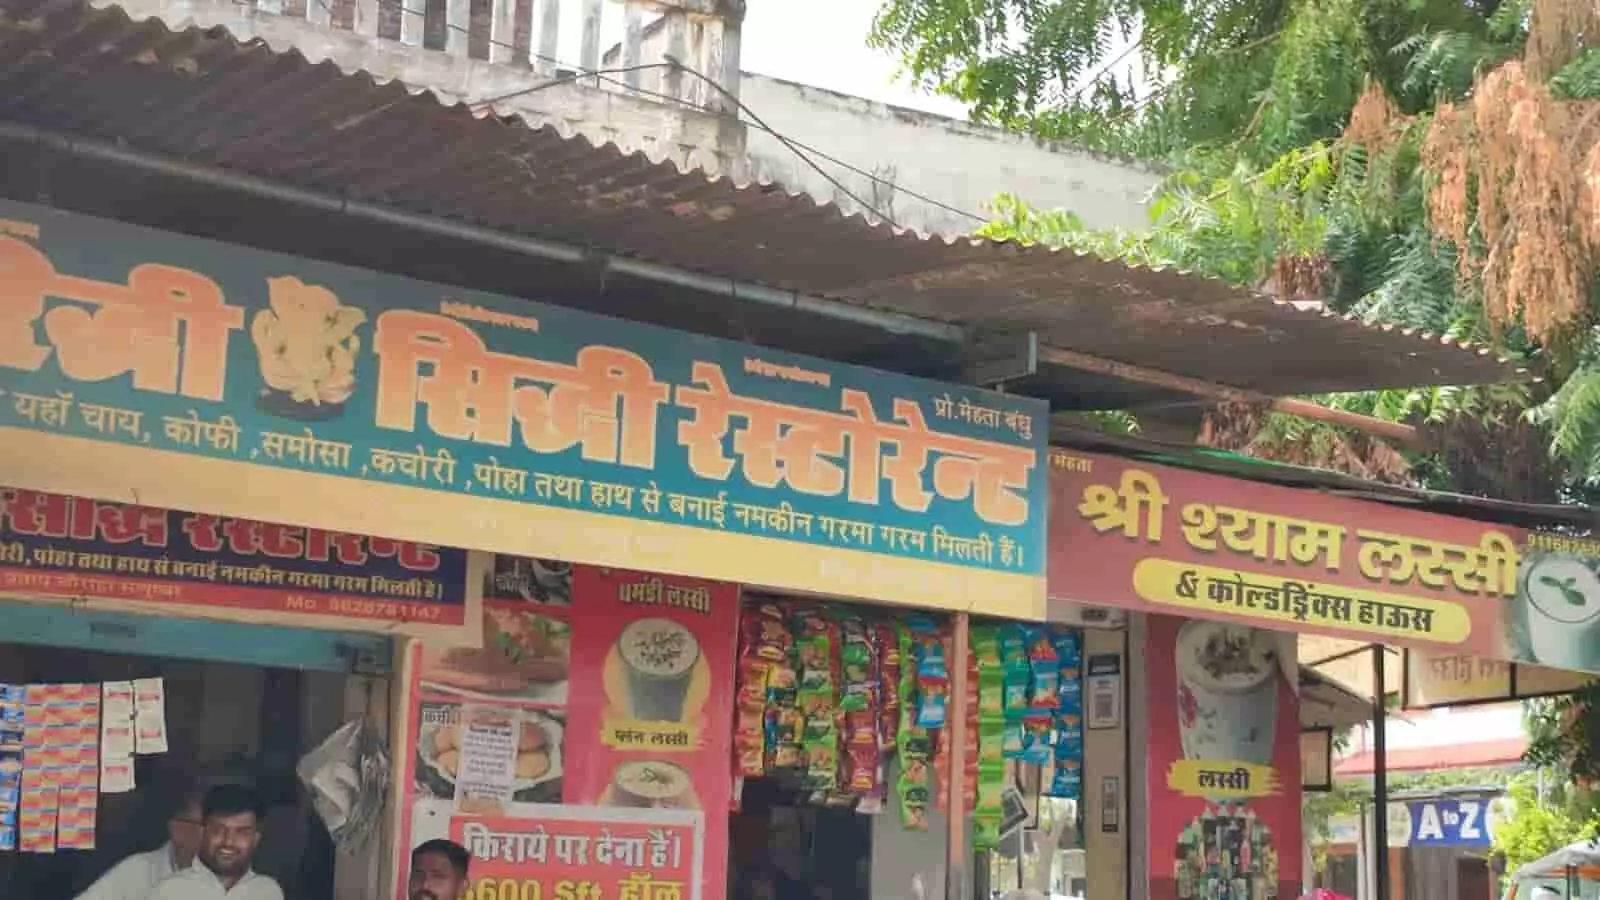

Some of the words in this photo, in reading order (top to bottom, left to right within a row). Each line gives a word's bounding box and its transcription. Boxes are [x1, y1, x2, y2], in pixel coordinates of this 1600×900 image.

[675, 360, 1035, 526] रेस्टोरेन्ट
[162, 411, 241, 454] कोफी
[533, 472, 584, 501] तथा
[589, 482, 634, 511] हाथ
[641, 481, 663, 513] से
[669, 491, 728, 528] बनाई
[733, 502, 813, 536] नमकीन
[819, 515, 874, 545] गरमा
[880, 526, 927, 553] गरम
[931, 524, 993, 563] मिलती
[1077, 469, 1169, 542] श्री
[1181, 503, 1347, 570] श्याम
[1357, 530, 1522, 596] लस्सी
[76, 550, 112, 569] तथा
[666, 585, 710, 612] लस्सी
[1175, 569, 1199, 599] &
[1358, 599, 1435, 633] हाऊस
[1198, 767, 1250, 790] लस्सी
[1417, 803, 1444, 840] A
[1460, 802, 1480, 839] Z
[464, 823, 549, 864] किराये
[553, 832, 590, 865] पर
[596, 831, 645, 868] देना
